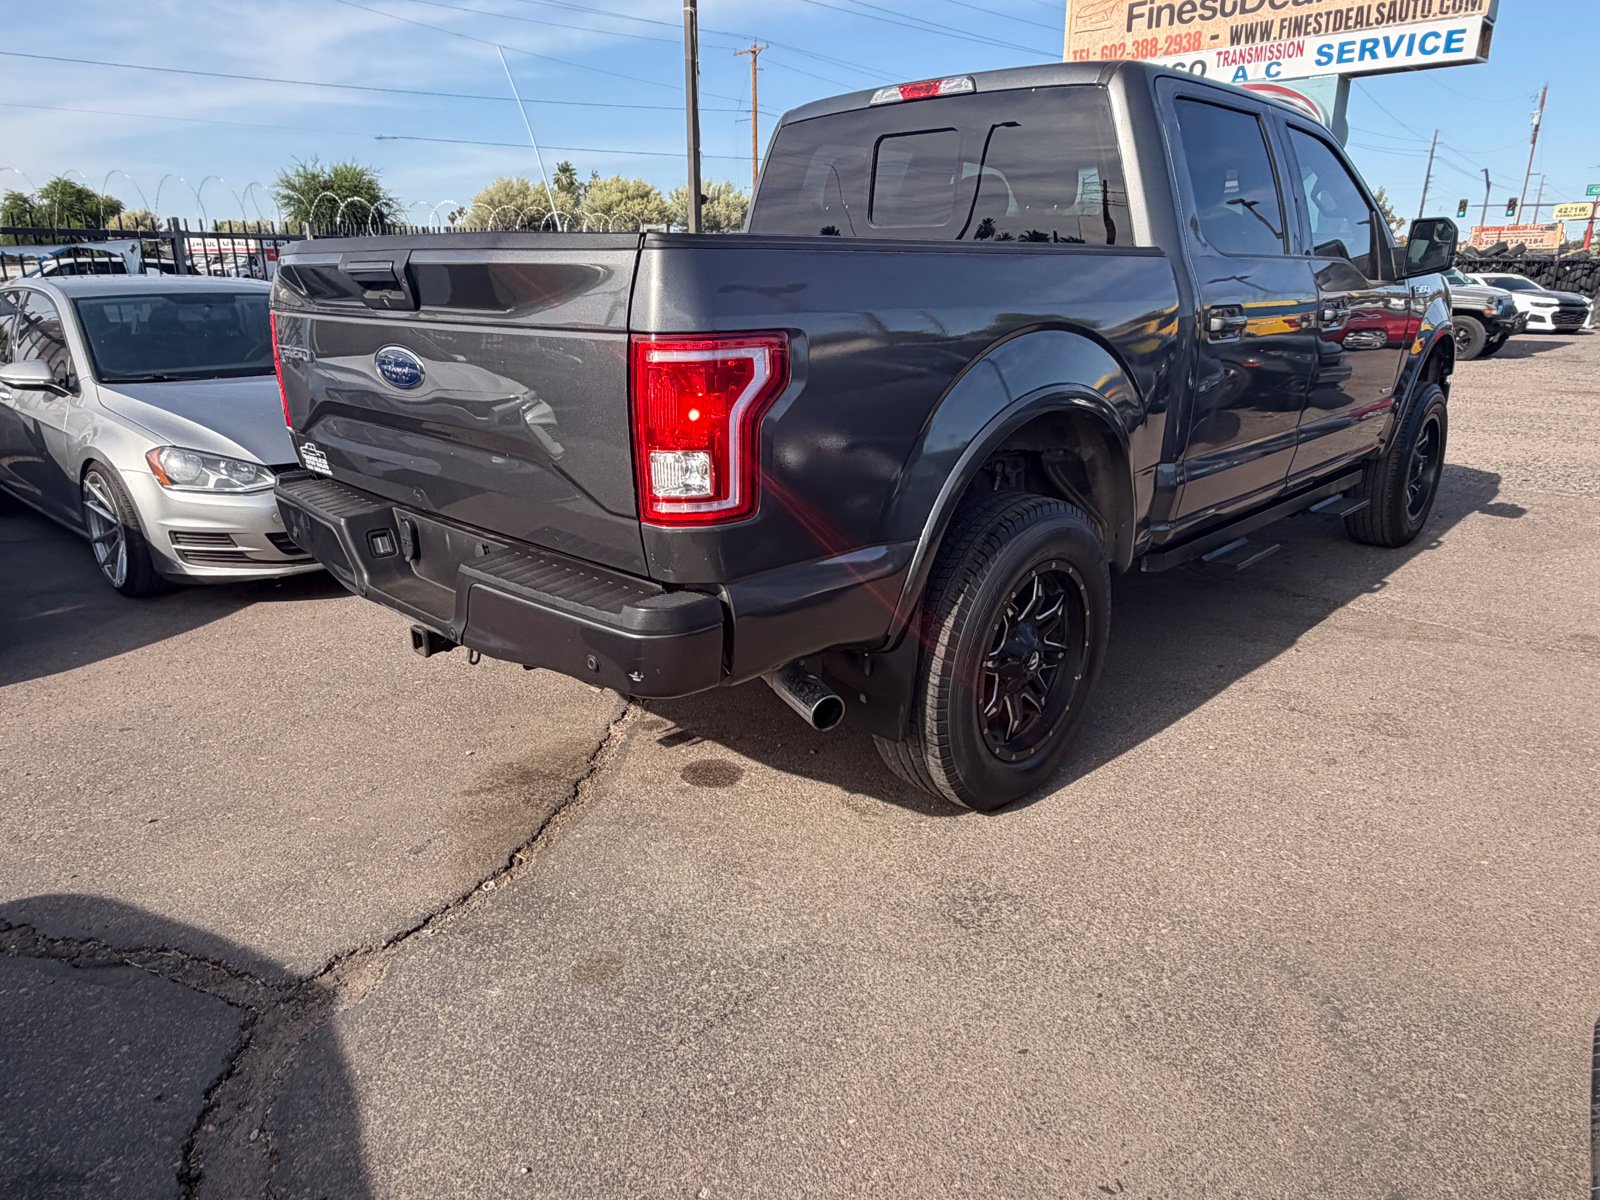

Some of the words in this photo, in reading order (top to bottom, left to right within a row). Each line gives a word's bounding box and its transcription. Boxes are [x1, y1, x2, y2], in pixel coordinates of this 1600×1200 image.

[1101, 31, 1202, 60] 602-388-2938
[1216, 40, 1305, 68] TRANSMISSION
[1314, 28, 1467, 67] SERVICE
[1232, 66, 1248, 82] A
[1265, 62, 1282, 78] C
